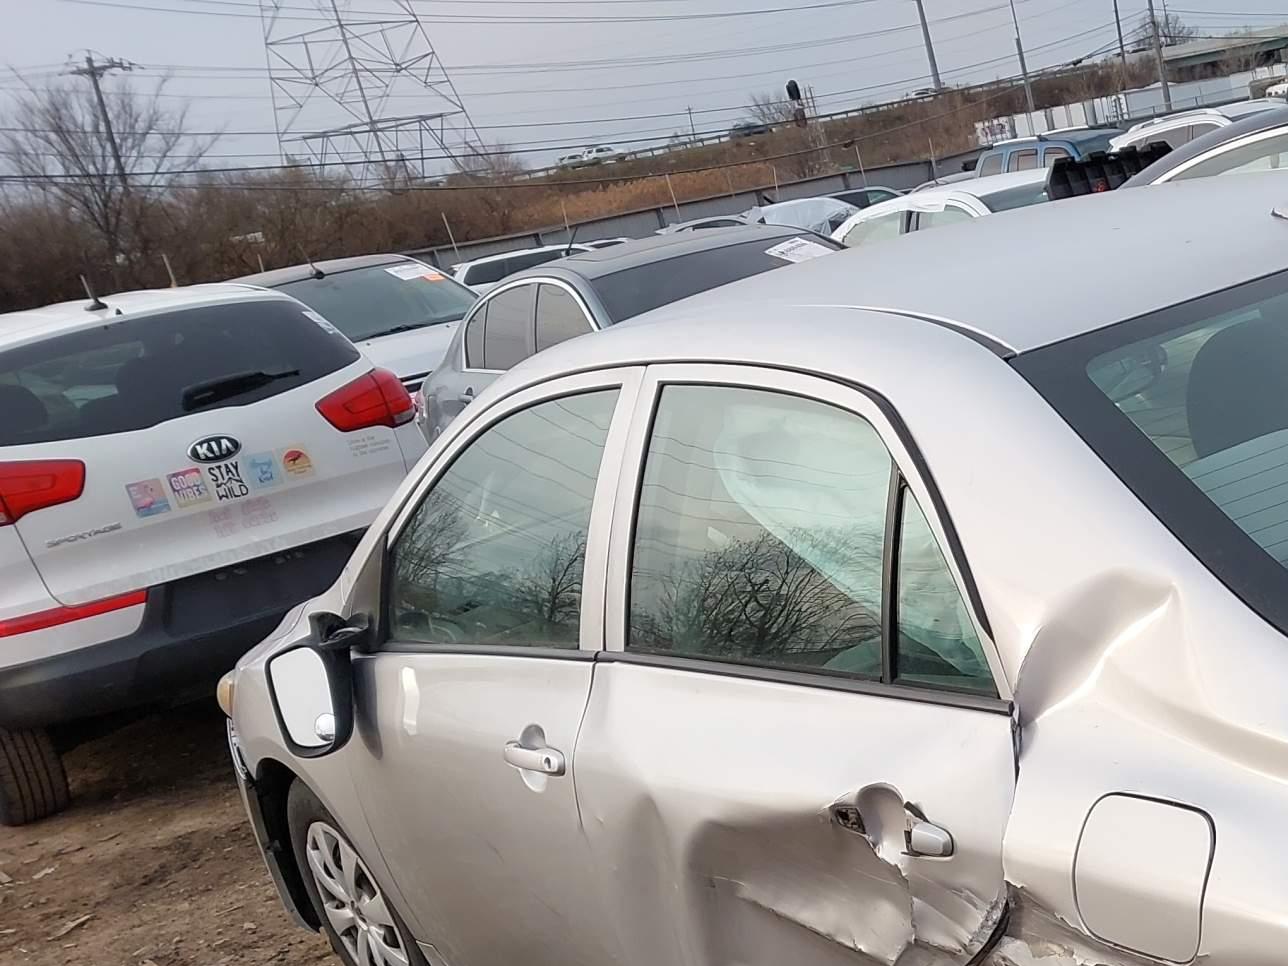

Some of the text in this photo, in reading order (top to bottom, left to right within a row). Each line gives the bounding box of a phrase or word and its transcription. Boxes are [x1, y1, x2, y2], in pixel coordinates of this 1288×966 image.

[194, 437, 236, 460] KIA
[207, 460, 241, 482] STAY
[215, 483, 249, 501] WILD
